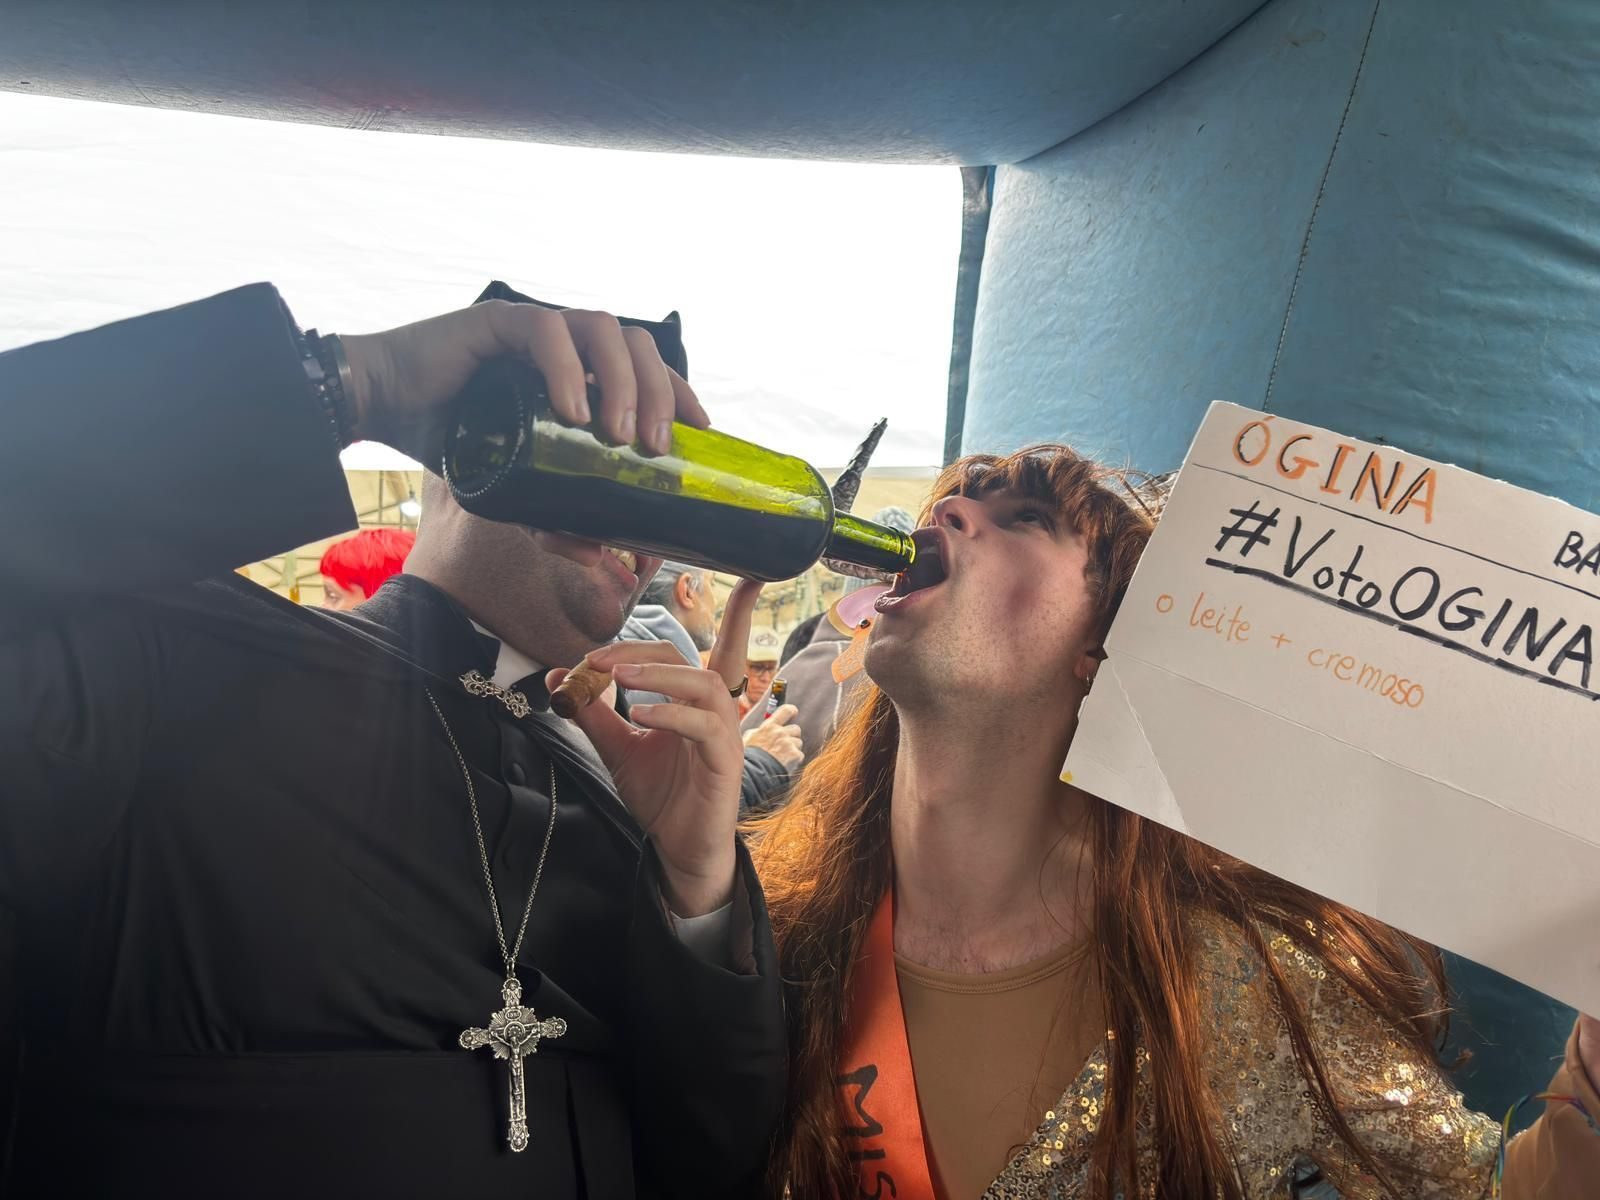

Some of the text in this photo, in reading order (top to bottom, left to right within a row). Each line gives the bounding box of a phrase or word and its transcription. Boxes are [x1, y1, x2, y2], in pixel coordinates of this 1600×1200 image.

[1232, 415, 1437, 524] ÓGINA
[1214, 500, 1593, 687] #VotoOGINA
[1553, 531, 1600, 576] BA
[1189, 592, 1251, 642] leite
[1307, 648, 1425, 708] cremoso
